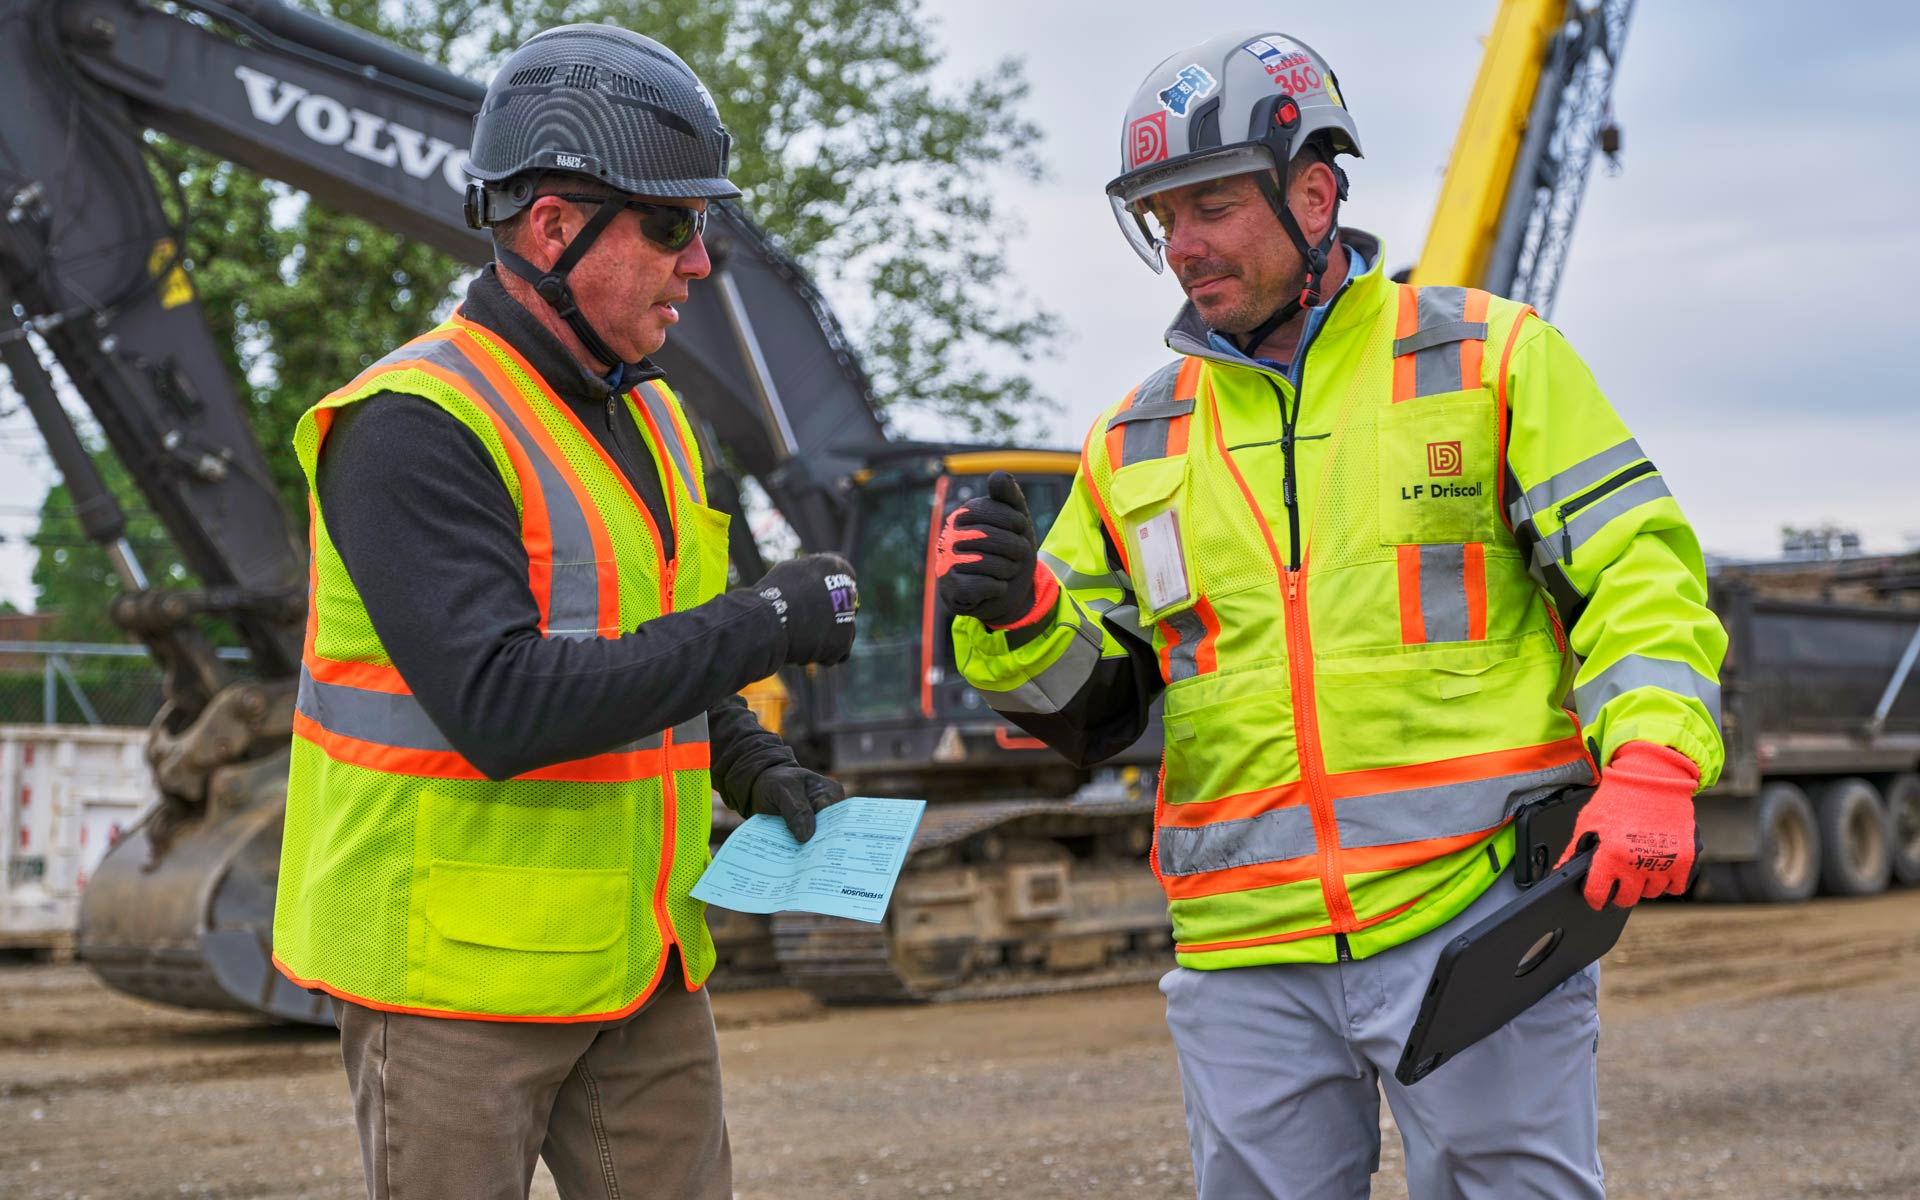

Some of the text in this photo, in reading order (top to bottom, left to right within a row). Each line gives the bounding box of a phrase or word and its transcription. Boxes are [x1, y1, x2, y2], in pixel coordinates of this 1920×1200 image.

[1274, 66, 1321, 97] 360
[556, 155, 582, 163] KLEIN
[1431, 481, 1482, 498] Driscoll
[840, 888, 878, 900] FERGUSON
